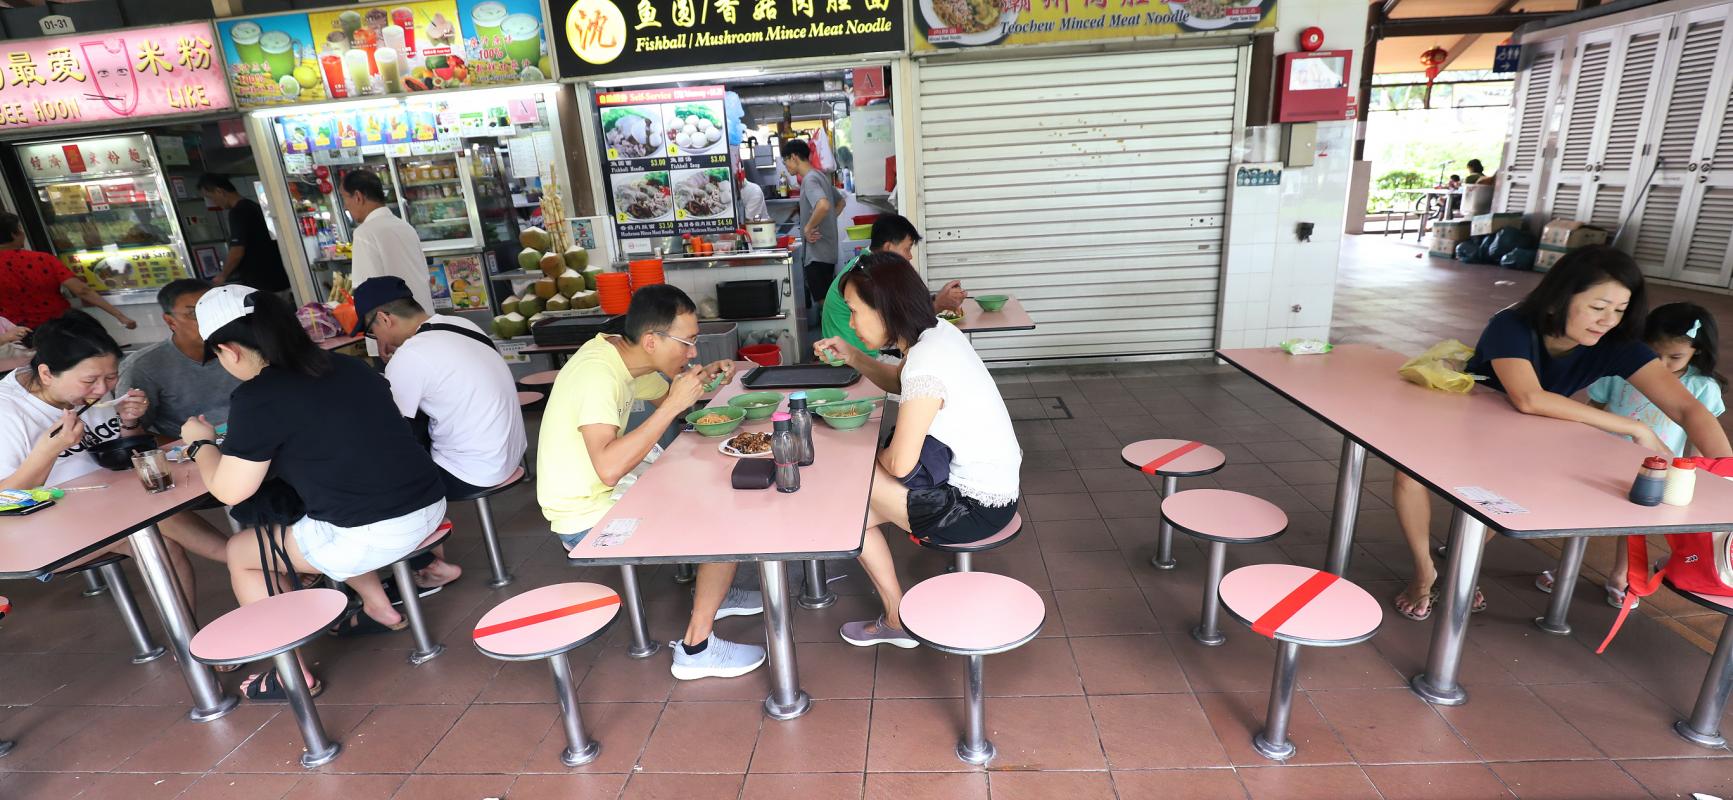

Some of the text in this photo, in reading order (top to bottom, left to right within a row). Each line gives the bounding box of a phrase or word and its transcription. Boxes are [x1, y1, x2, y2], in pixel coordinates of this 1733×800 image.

[44, 18, 68, 29] 01-31
[1001, 9, 1190, 34] Teochew Minced Meat Noodle
[635, 33, 687, 53] Fishball
[695, 30, 763, 48] Mushroom
[764, 25, 807, 41] Mince
[808, 22, 844, 38] Meat
[846, 17, 892, 34] Noodle
[480, 48, 503, 60] 100%
[863, 72, 874, 88] A
[33, 97, 82, 122] HOON
[167, 85, 211, 109] LIKE
[651, 159, 666, 167] $3.00
[711, 154, 726, 163] $3.00
[659, 221, 674, 229] $3.50
[717, 217, 733, 226] $4.50
